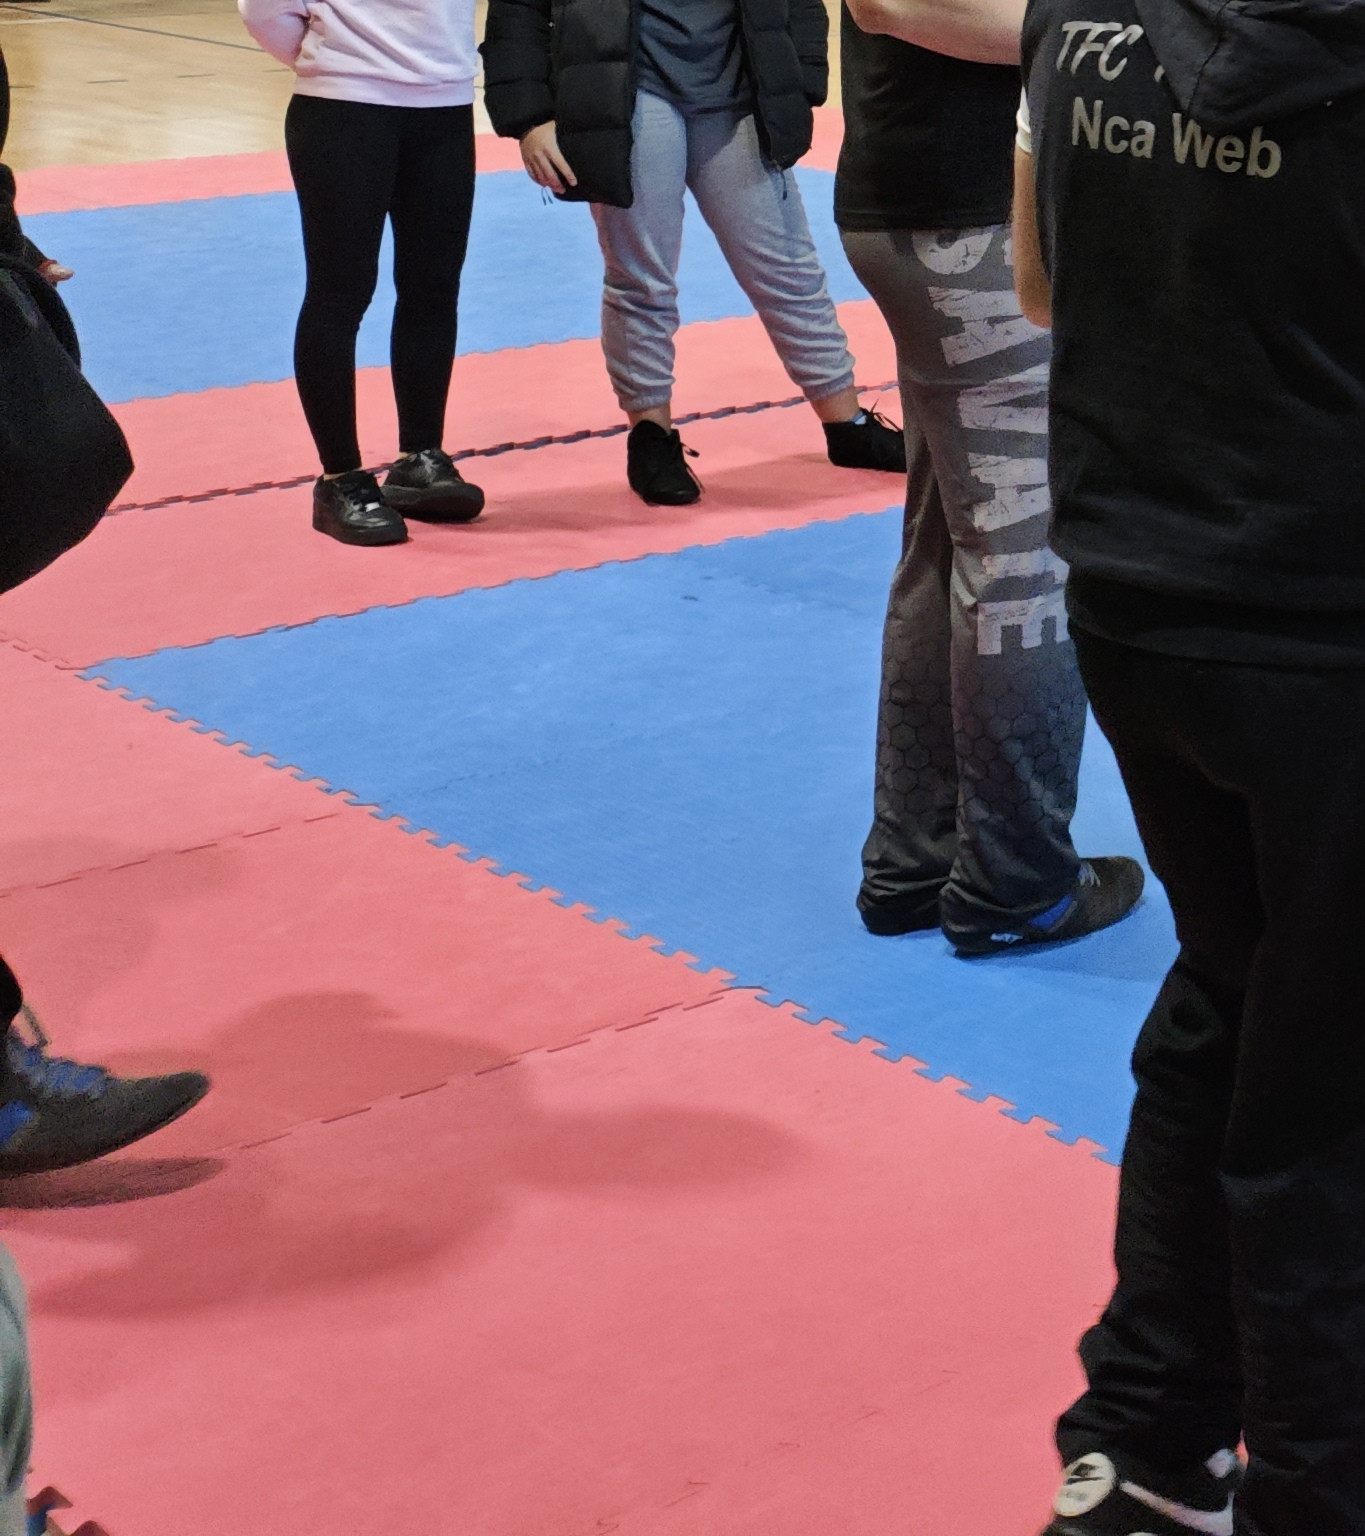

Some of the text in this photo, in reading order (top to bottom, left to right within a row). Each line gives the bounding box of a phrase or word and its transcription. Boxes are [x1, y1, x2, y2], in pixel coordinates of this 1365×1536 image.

[1056, 20, 1144, 81] TFC
[1072, 96, 1282, 179] Nca Web
